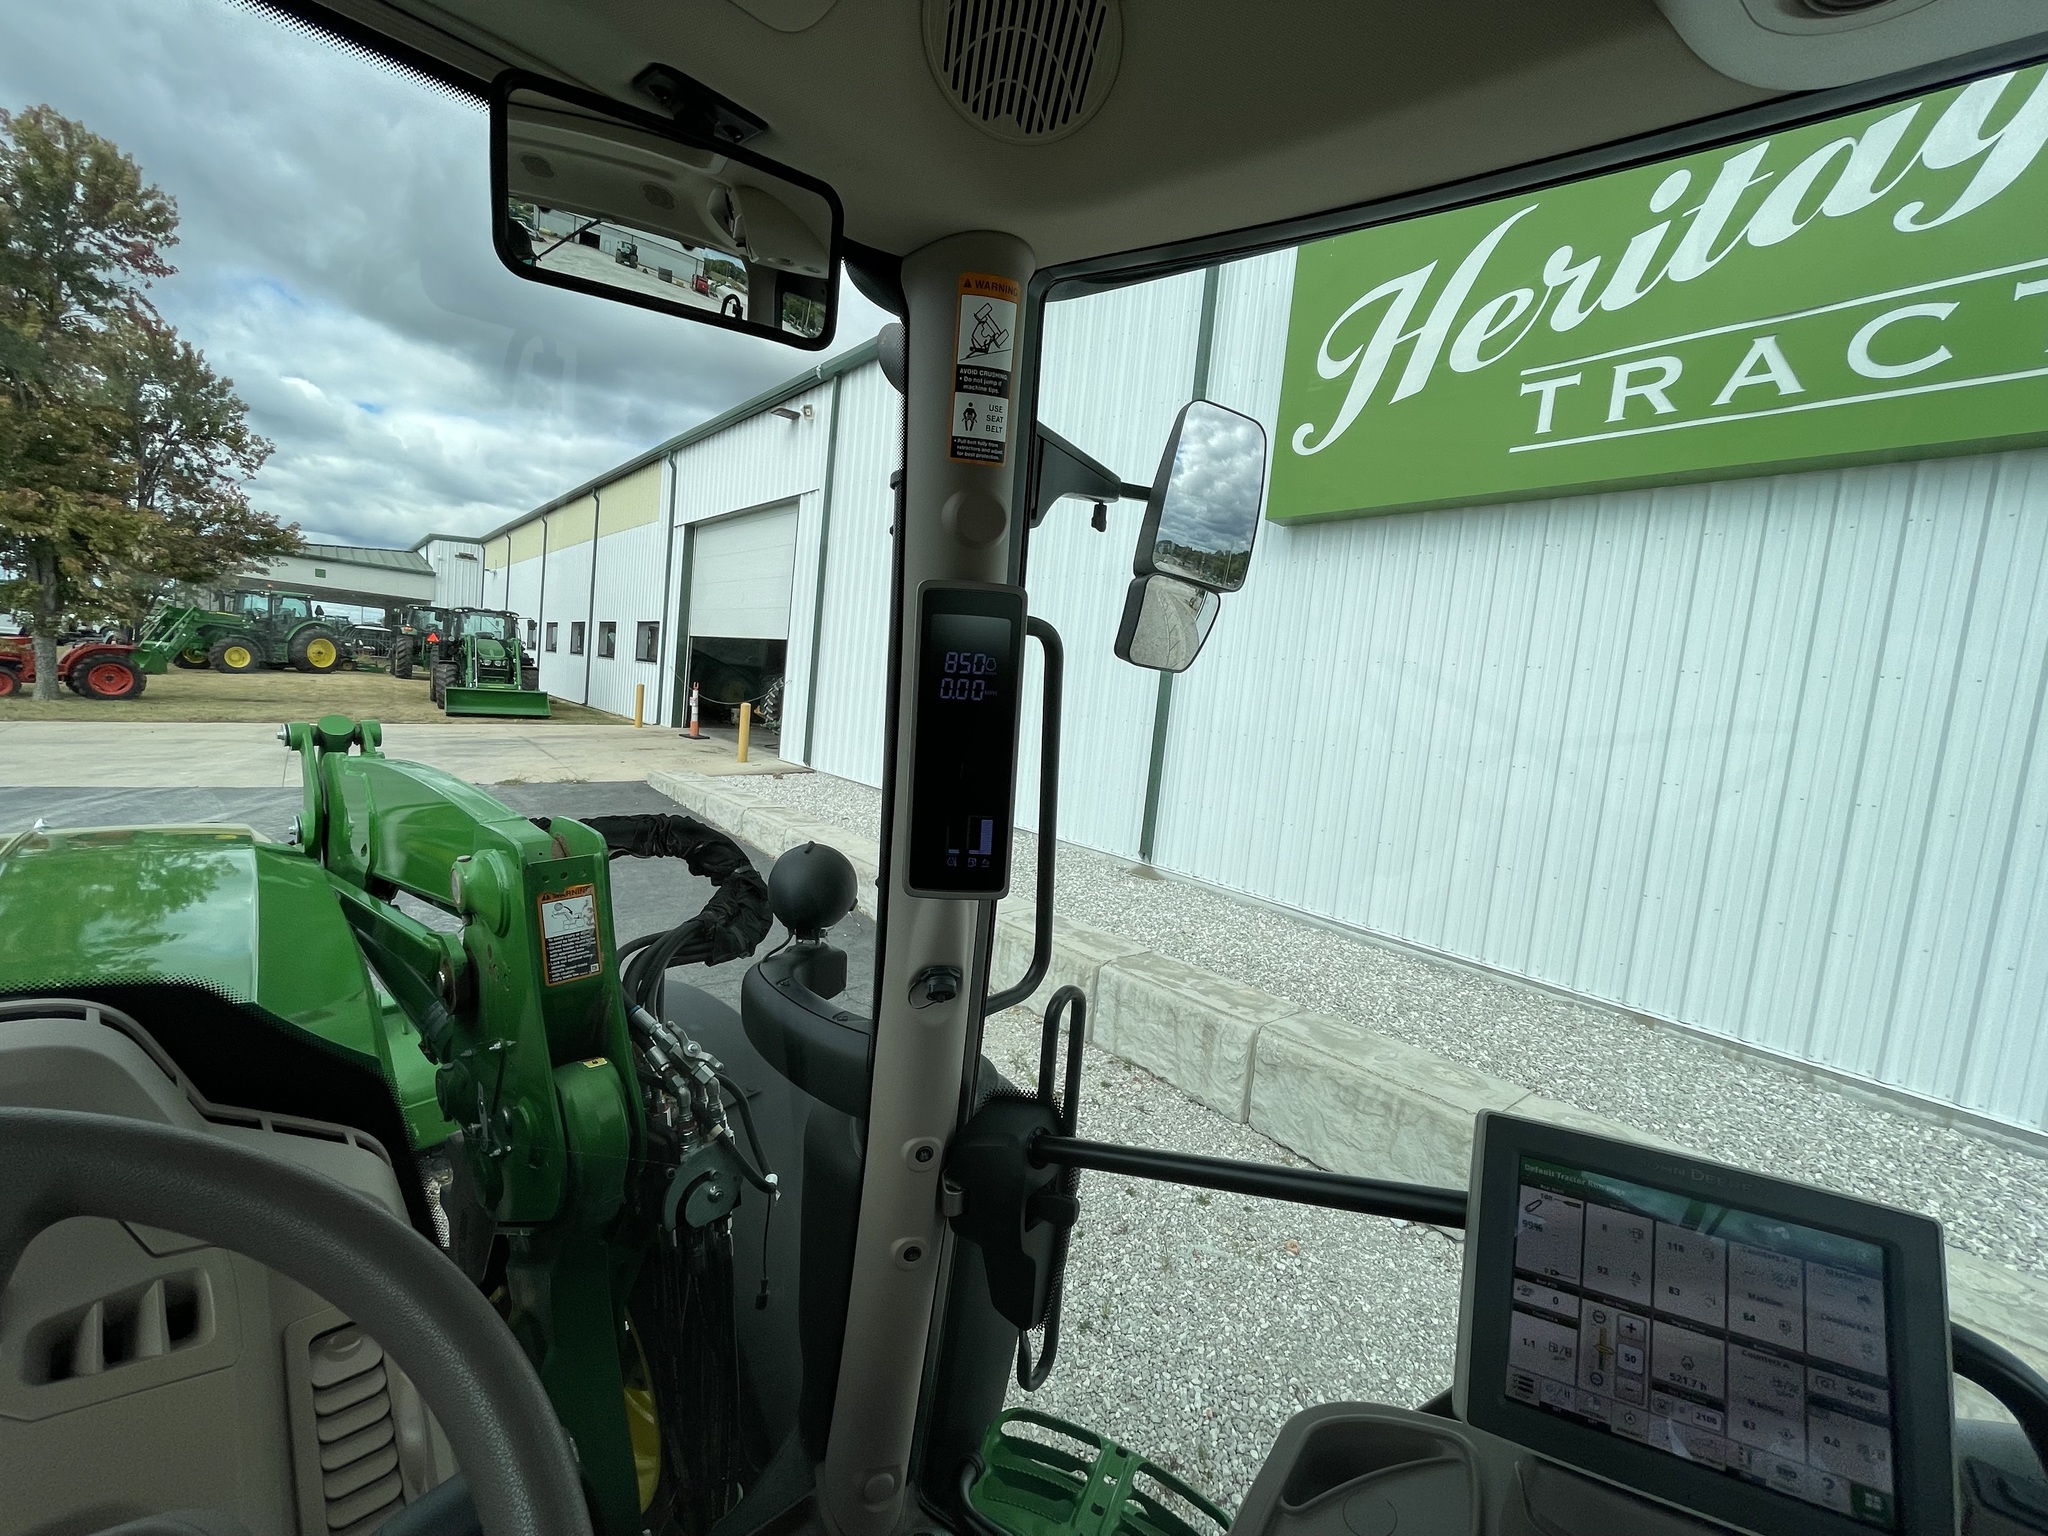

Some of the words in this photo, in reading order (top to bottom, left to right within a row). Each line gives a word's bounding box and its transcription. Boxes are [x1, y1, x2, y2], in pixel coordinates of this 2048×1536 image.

[975, 279, 1018, 296] WARNING
[989, 404, 1003, 413] USE
[986, 415, 1004, 423] SEAT
[985, 425, 1003, 433] BELT
[945, 652, 986, 675] 850
[940, 678, 985, 701] 0.00
[1524, 1162, 1555, 1178] Default
[1556, 1171, 1585, 1186] Tractor
[1521, 1218, 1543, 1233] 99%
[1552, 1295, 1559, 1306] 0
[1521, 1336, 1536, 1349] 1.1
[1623, 1352, 1636, 1365] 50
